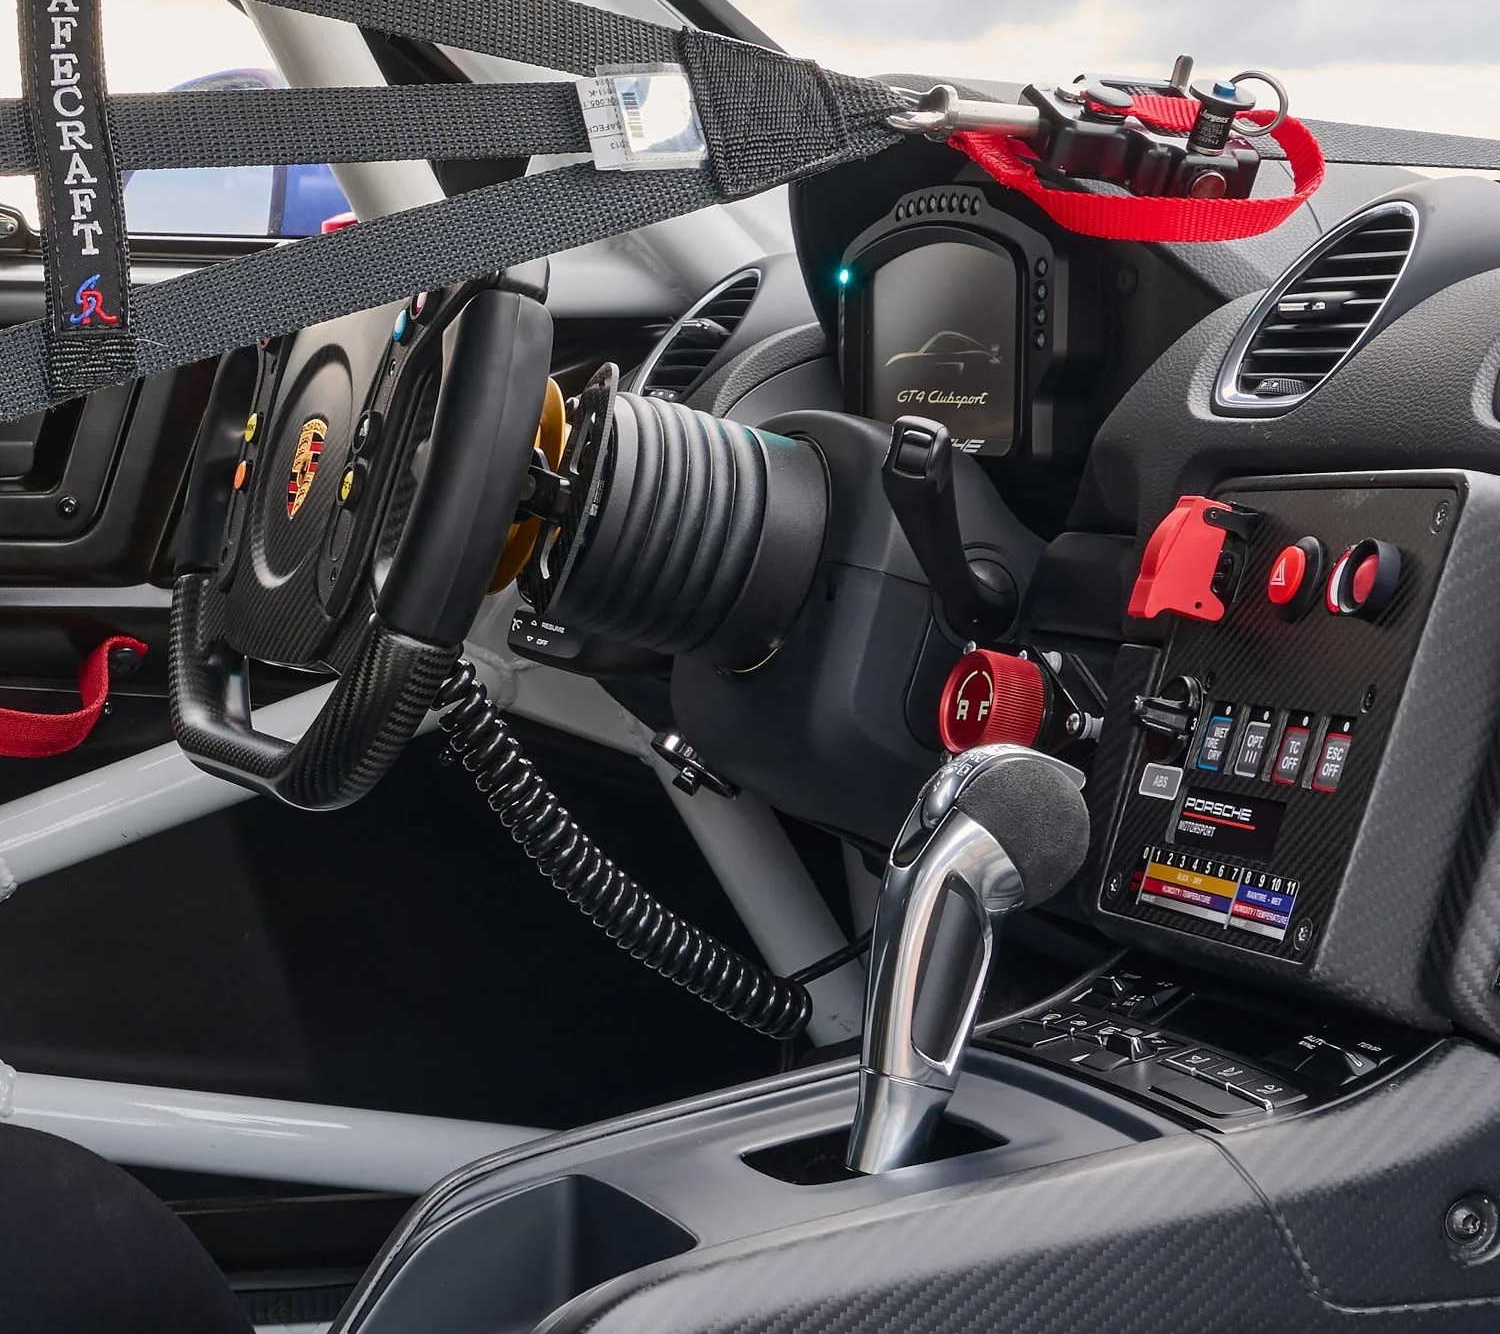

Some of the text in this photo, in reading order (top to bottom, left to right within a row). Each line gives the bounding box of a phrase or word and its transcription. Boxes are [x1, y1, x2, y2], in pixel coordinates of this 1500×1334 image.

[896, 389, 990, 409] GT4 Clubsport
[541, 621, 566, 635] RESUME
[535, 637, 549, 647] OFF
[976, 700, 990, 722] F
[1289, 740, 1301, 755] TC
[1326, 746, 1345, 762] ESC
[1281, 755, 1300, 771] OFF
[1321, 762, 1341, 778] OFF
[1152, 774, 1169, 789] ABS
[1184, 796, 1253, 822] PORSCHE
[1177, 819, 1217, 838] MOTORSPORT
